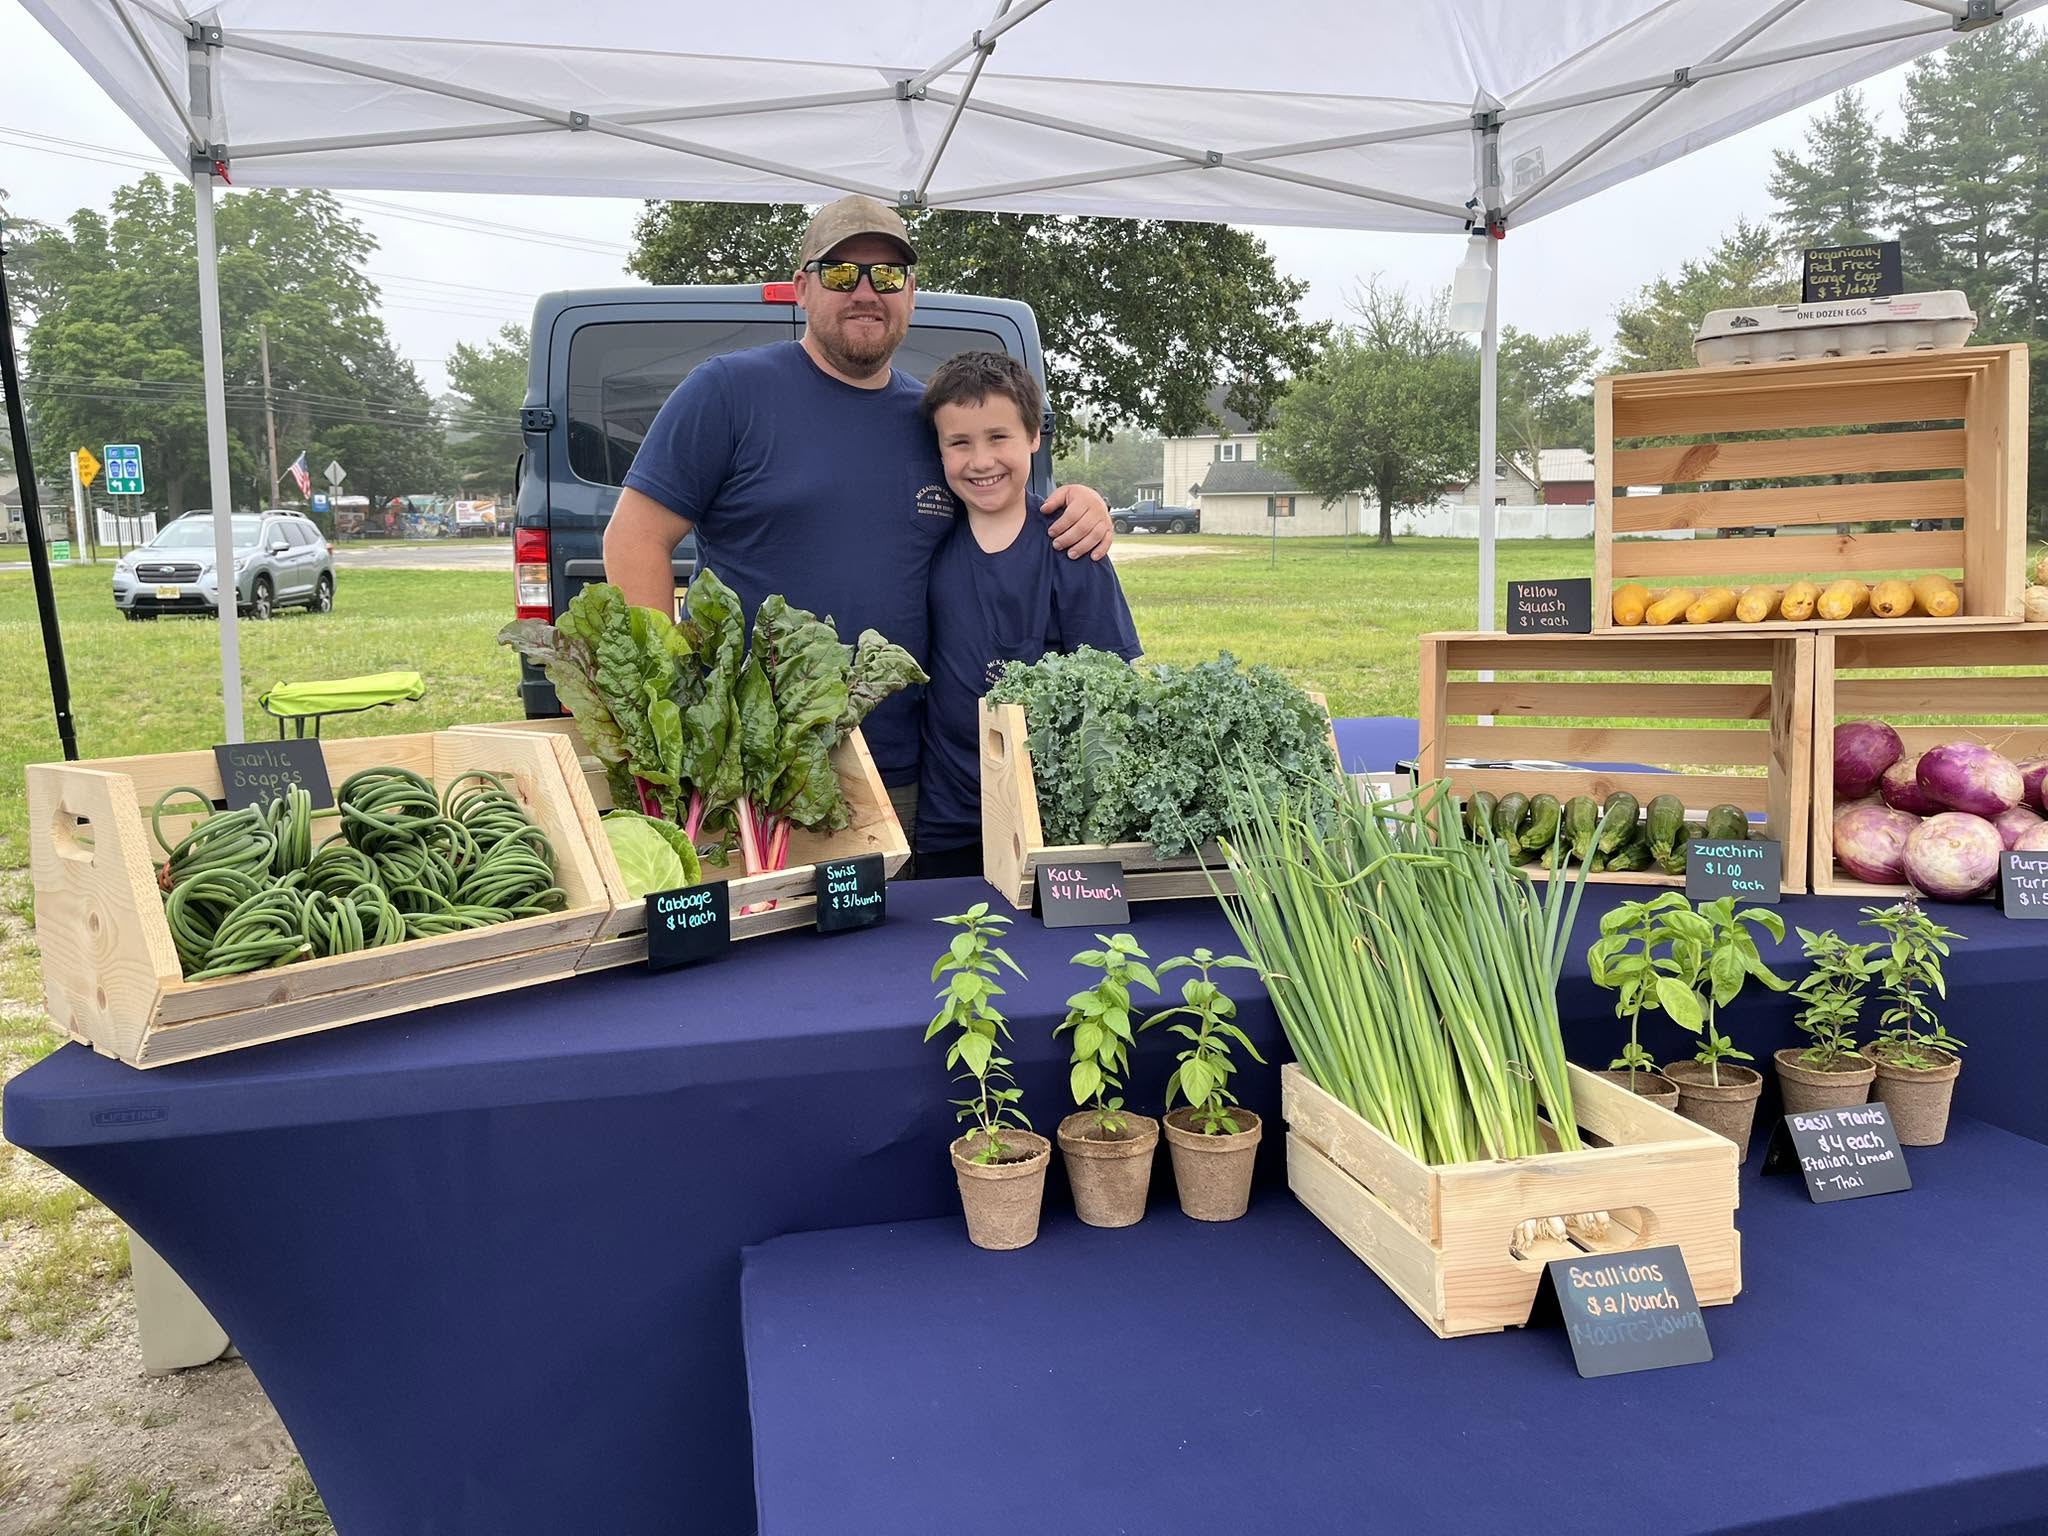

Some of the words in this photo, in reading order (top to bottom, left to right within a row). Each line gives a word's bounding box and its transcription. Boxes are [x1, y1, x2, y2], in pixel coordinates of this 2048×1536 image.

[1809, 248, 1881, 260] Organically
[1854, 271, 1882, 288] Eggs
[1797, 311, 1814, 320] ONE
[1816, 310, 1844, 319] DOZEN
[1846, 307, 1867, 317] EGGS
[1518, 584, 1558, 598] Yellow
[1540, 616, 1569, 627] each
[229, 748, 291, 768] Garlic
[235, 770, 302, 788] Scapes
[826, 864, 856, 880] Swiss
[1704, 861, 1742, 877] $1.00
[828, 877, 857, 894] Chard
[1731, 879, 1765, 891] each
[657, 891, 713, 914] Cabbage
[689, 909, 717, 928] each
[101, 1109, 161, 1122] LIFETIME
[1793, 1114, 1833, 1132] Basil
[1837, 1108, 1886, 1127] Plants
[1818, 1134, 1845, 1153] $4
[1846, 1130, 1885, 1150] each
[1829, 1171, 1865, 1190] Thai
[1569, 1264, 1664, 1289] Scallions
